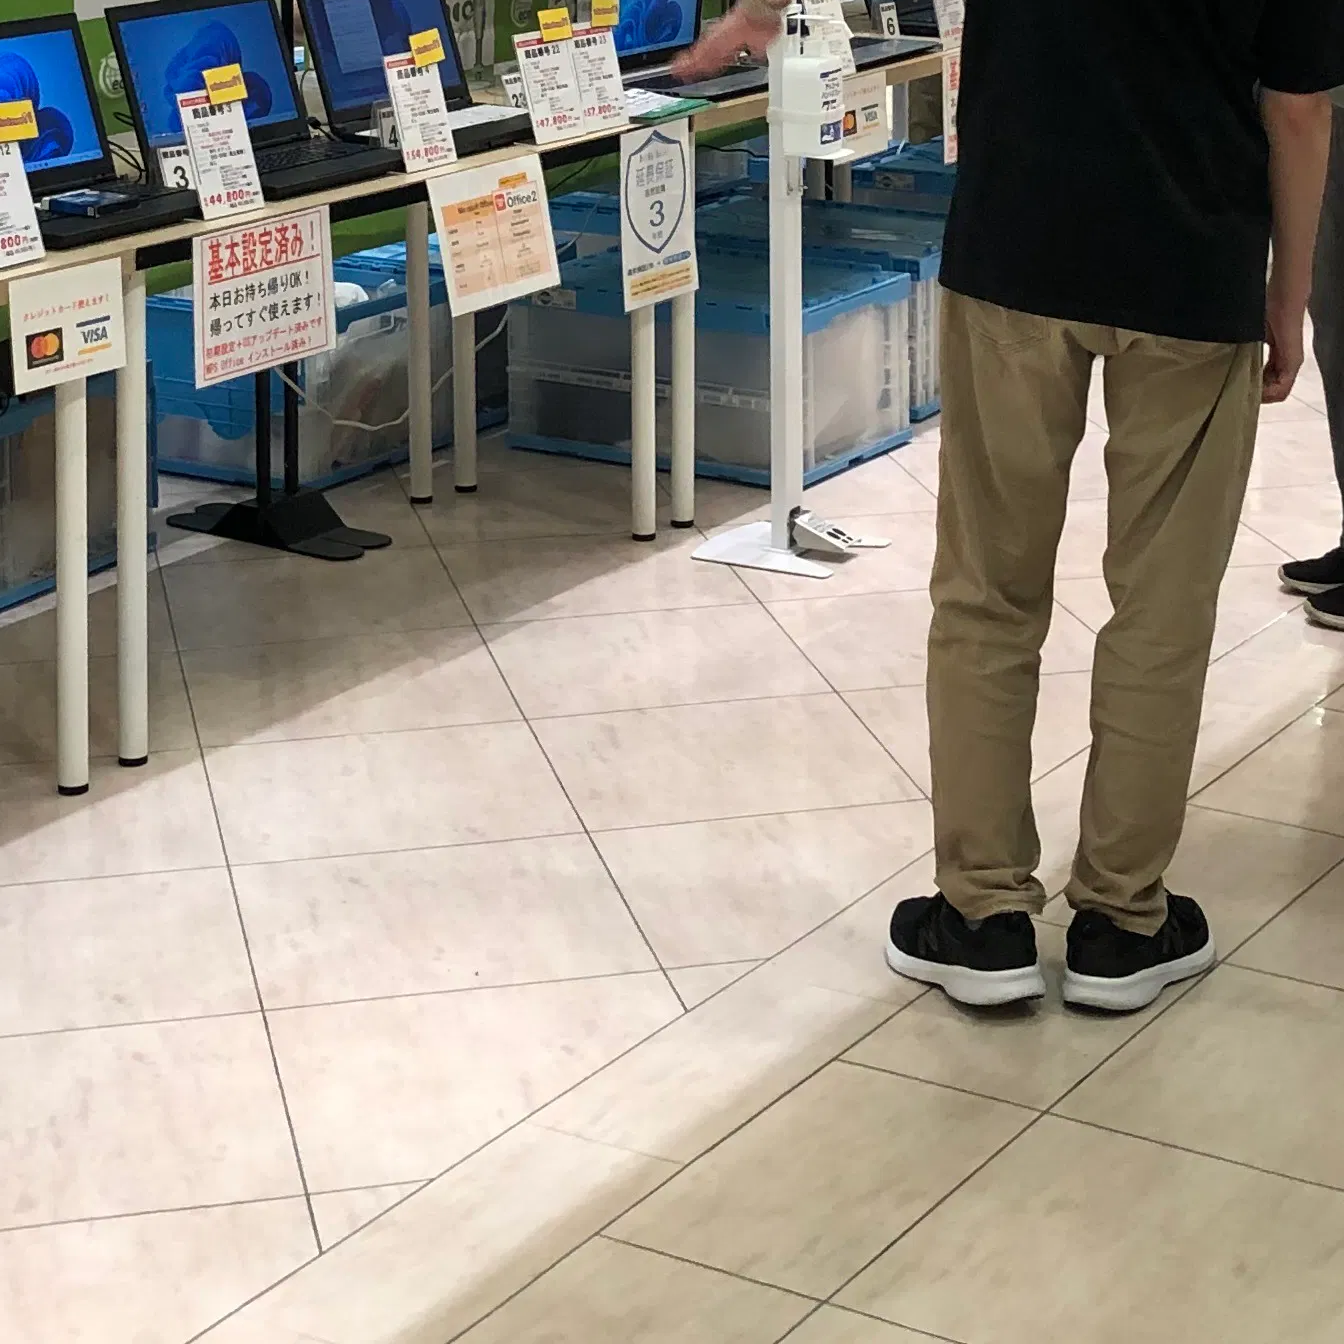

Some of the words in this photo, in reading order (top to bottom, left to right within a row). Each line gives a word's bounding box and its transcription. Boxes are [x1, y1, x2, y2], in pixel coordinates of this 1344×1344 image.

[886, 17, 895, 35] 6
[389, 125, 399, 148] 4
[0, 145, 11, 156] 12
[173, 166, 190, 190] 3
[649, 199, 665, 227] 3
[81, 326, 108, 344] VISA
